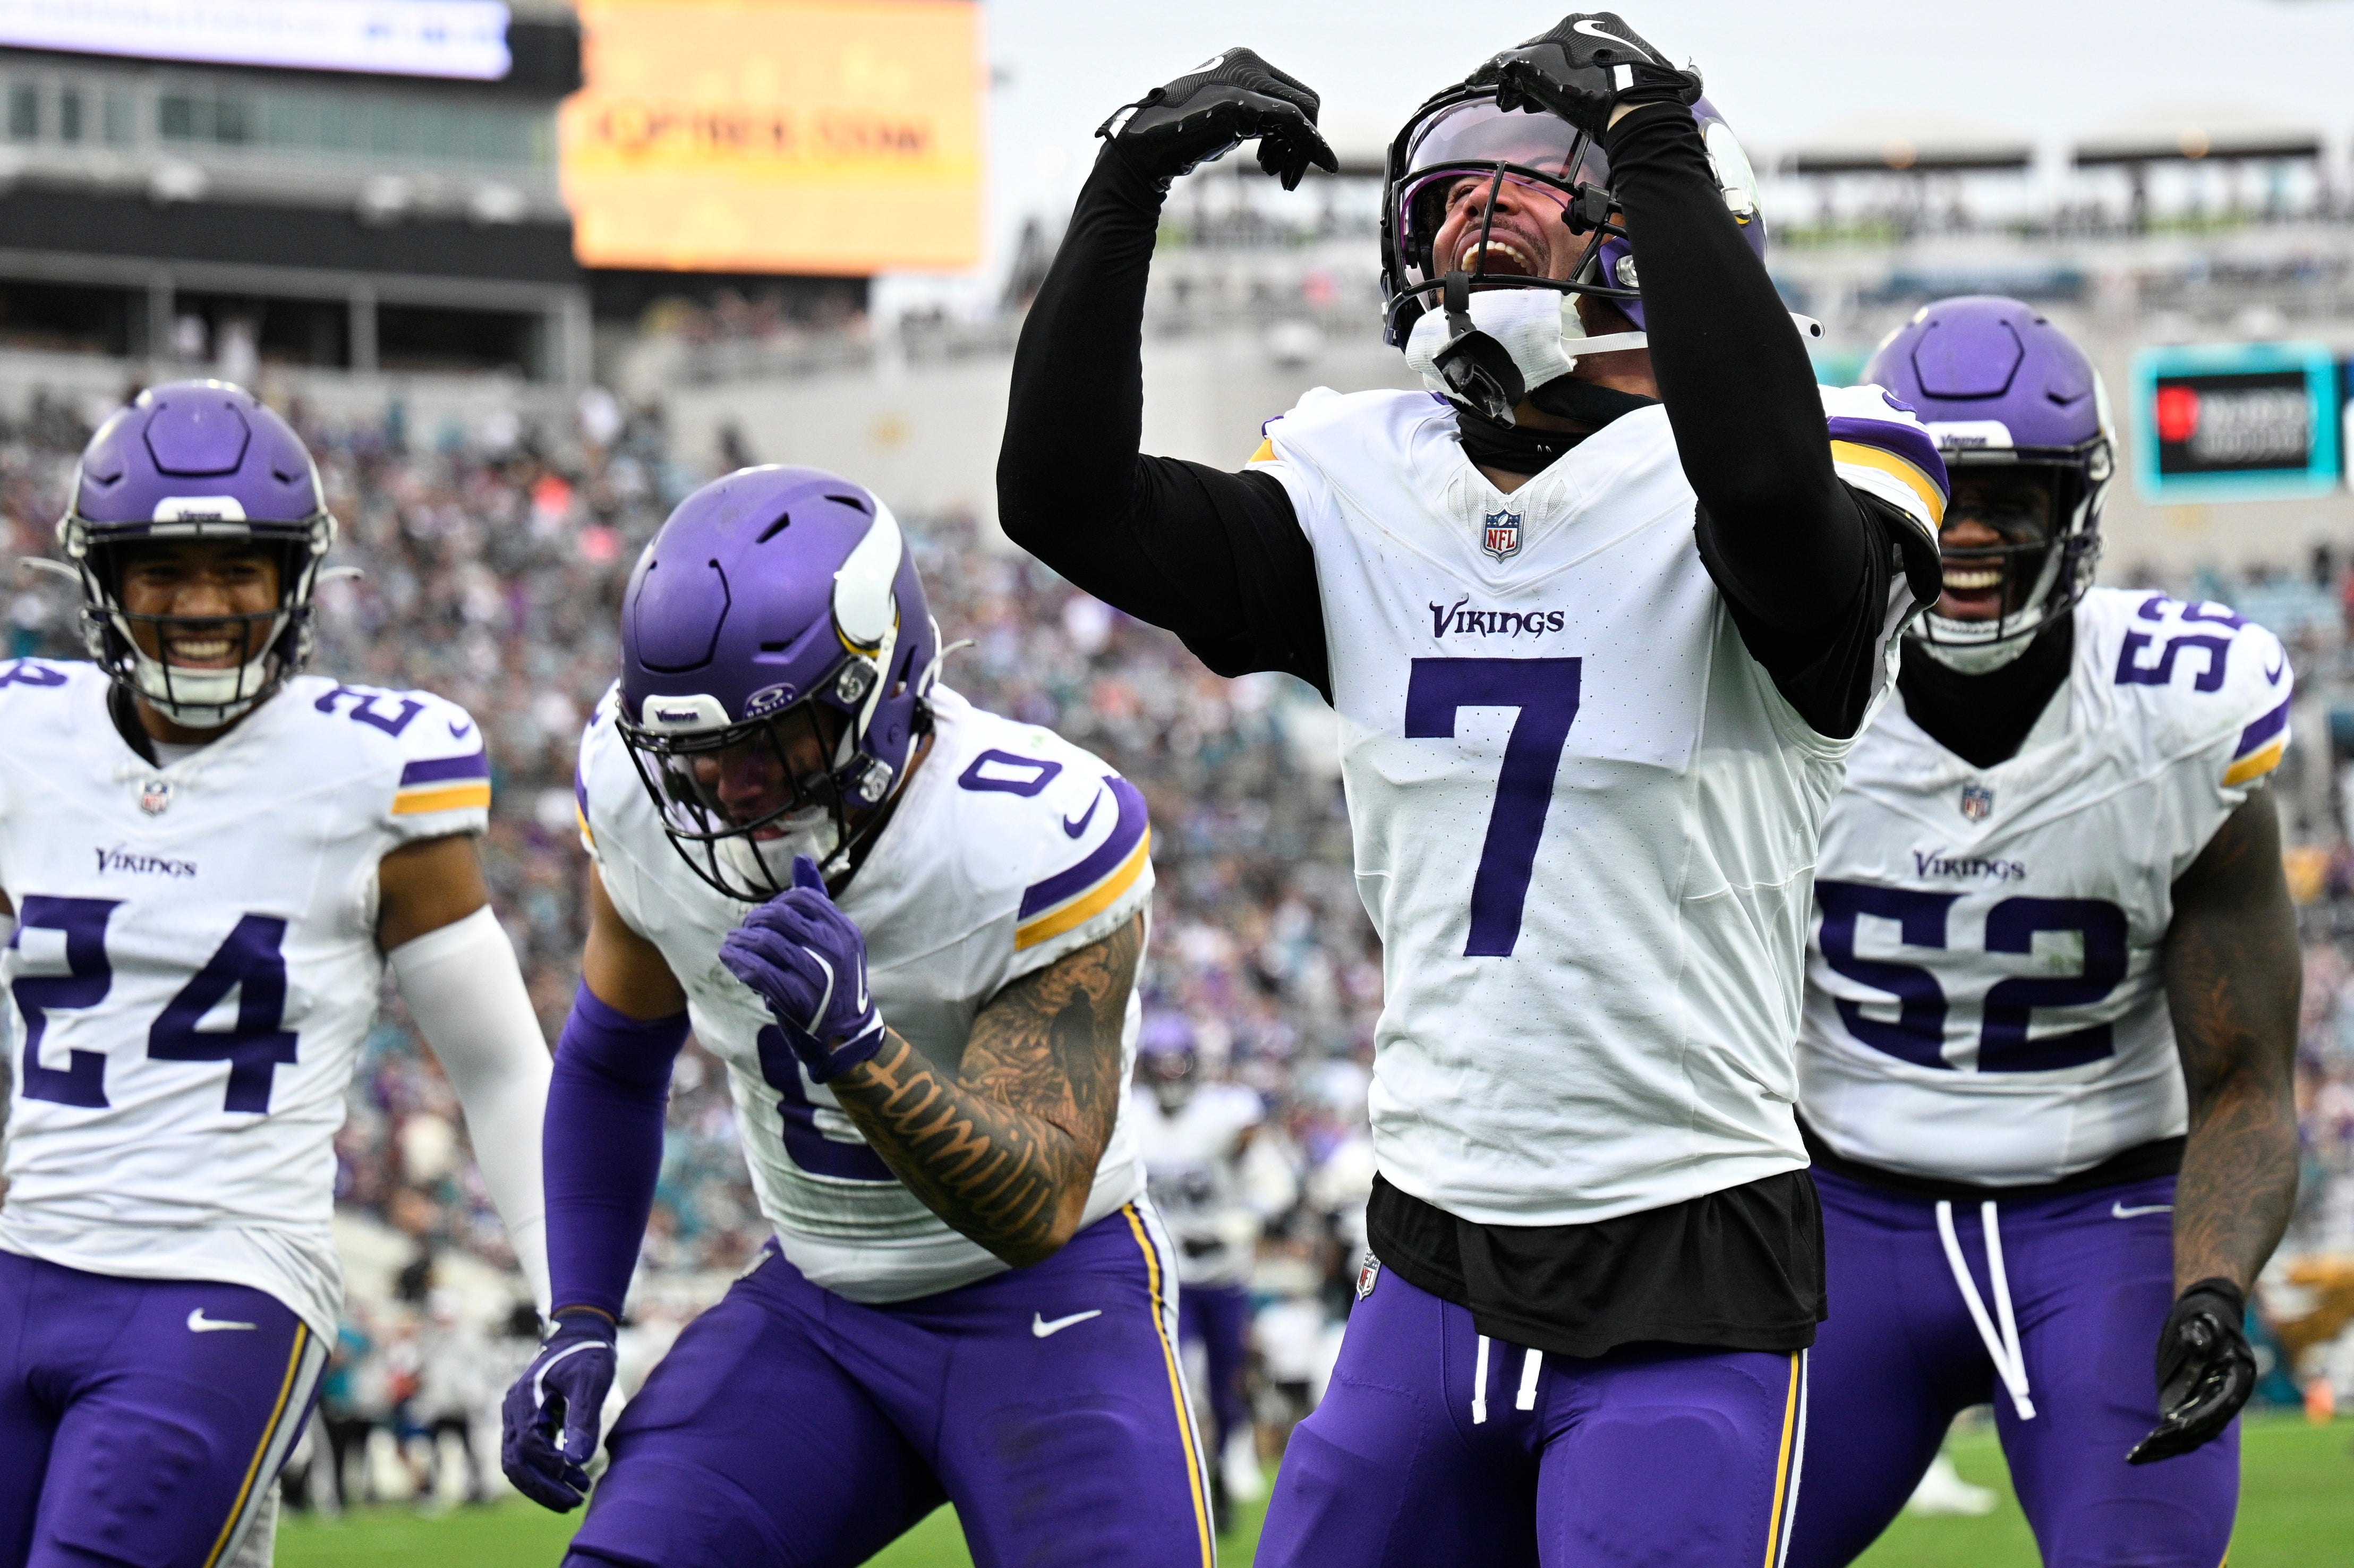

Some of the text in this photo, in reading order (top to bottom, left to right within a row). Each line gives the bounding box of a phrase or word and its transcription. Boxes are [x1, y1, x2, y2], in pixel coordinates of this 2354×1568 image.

[1487, 529, 1515, 551] NFL
[958, 748, 1062, 797] 0
[1405, 657, 1582, 957] 7
[7, 894, 299, 1115] 24
[1814, 880, 2129, 1073] 52
